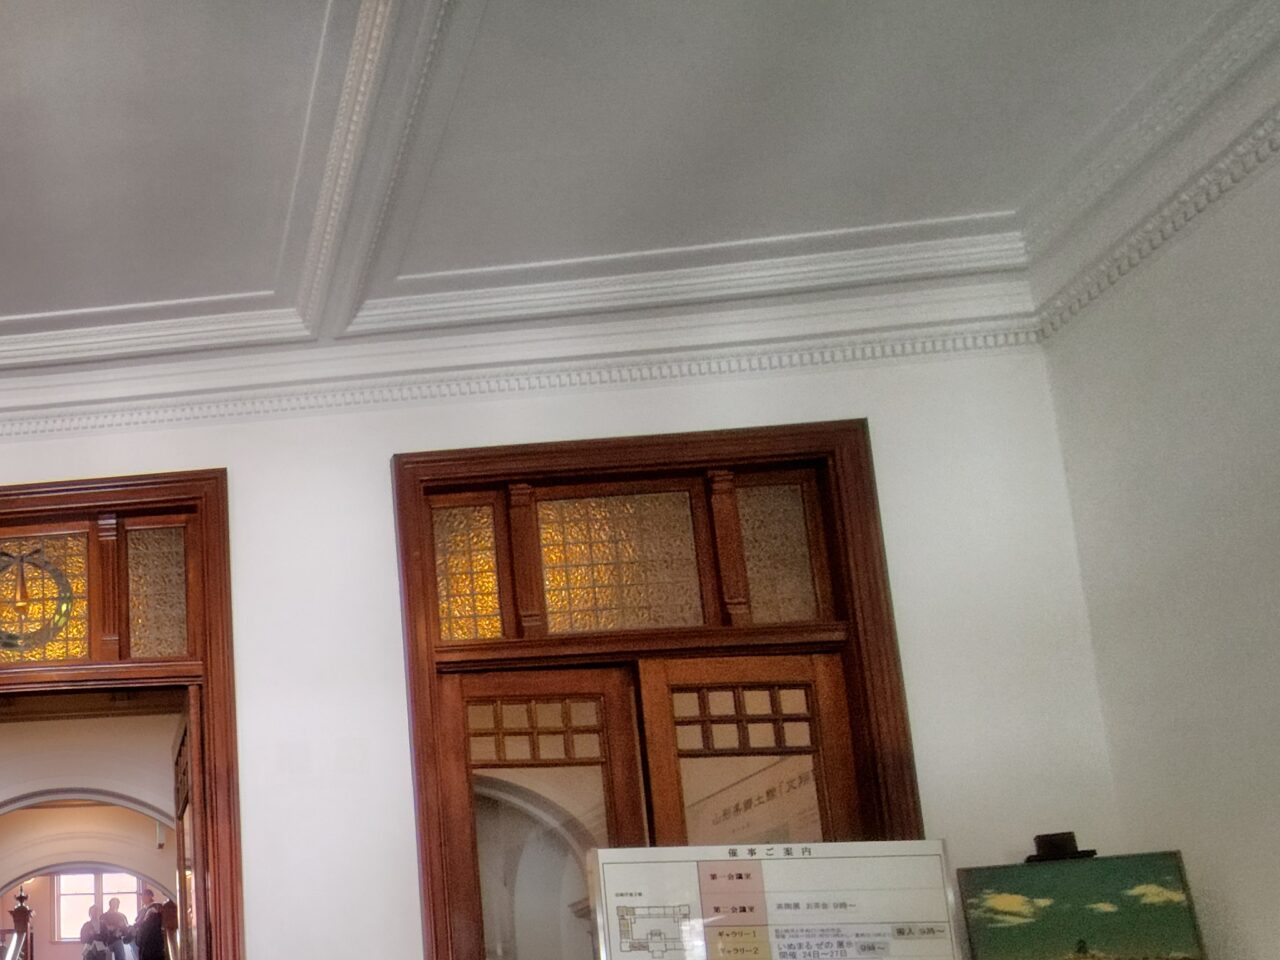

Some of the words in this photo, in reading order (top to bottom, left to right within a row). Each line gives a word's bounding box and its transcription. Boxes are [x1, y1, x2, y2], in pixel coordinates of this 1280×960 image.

[728, 846, 812, 857] 催事ご案内
